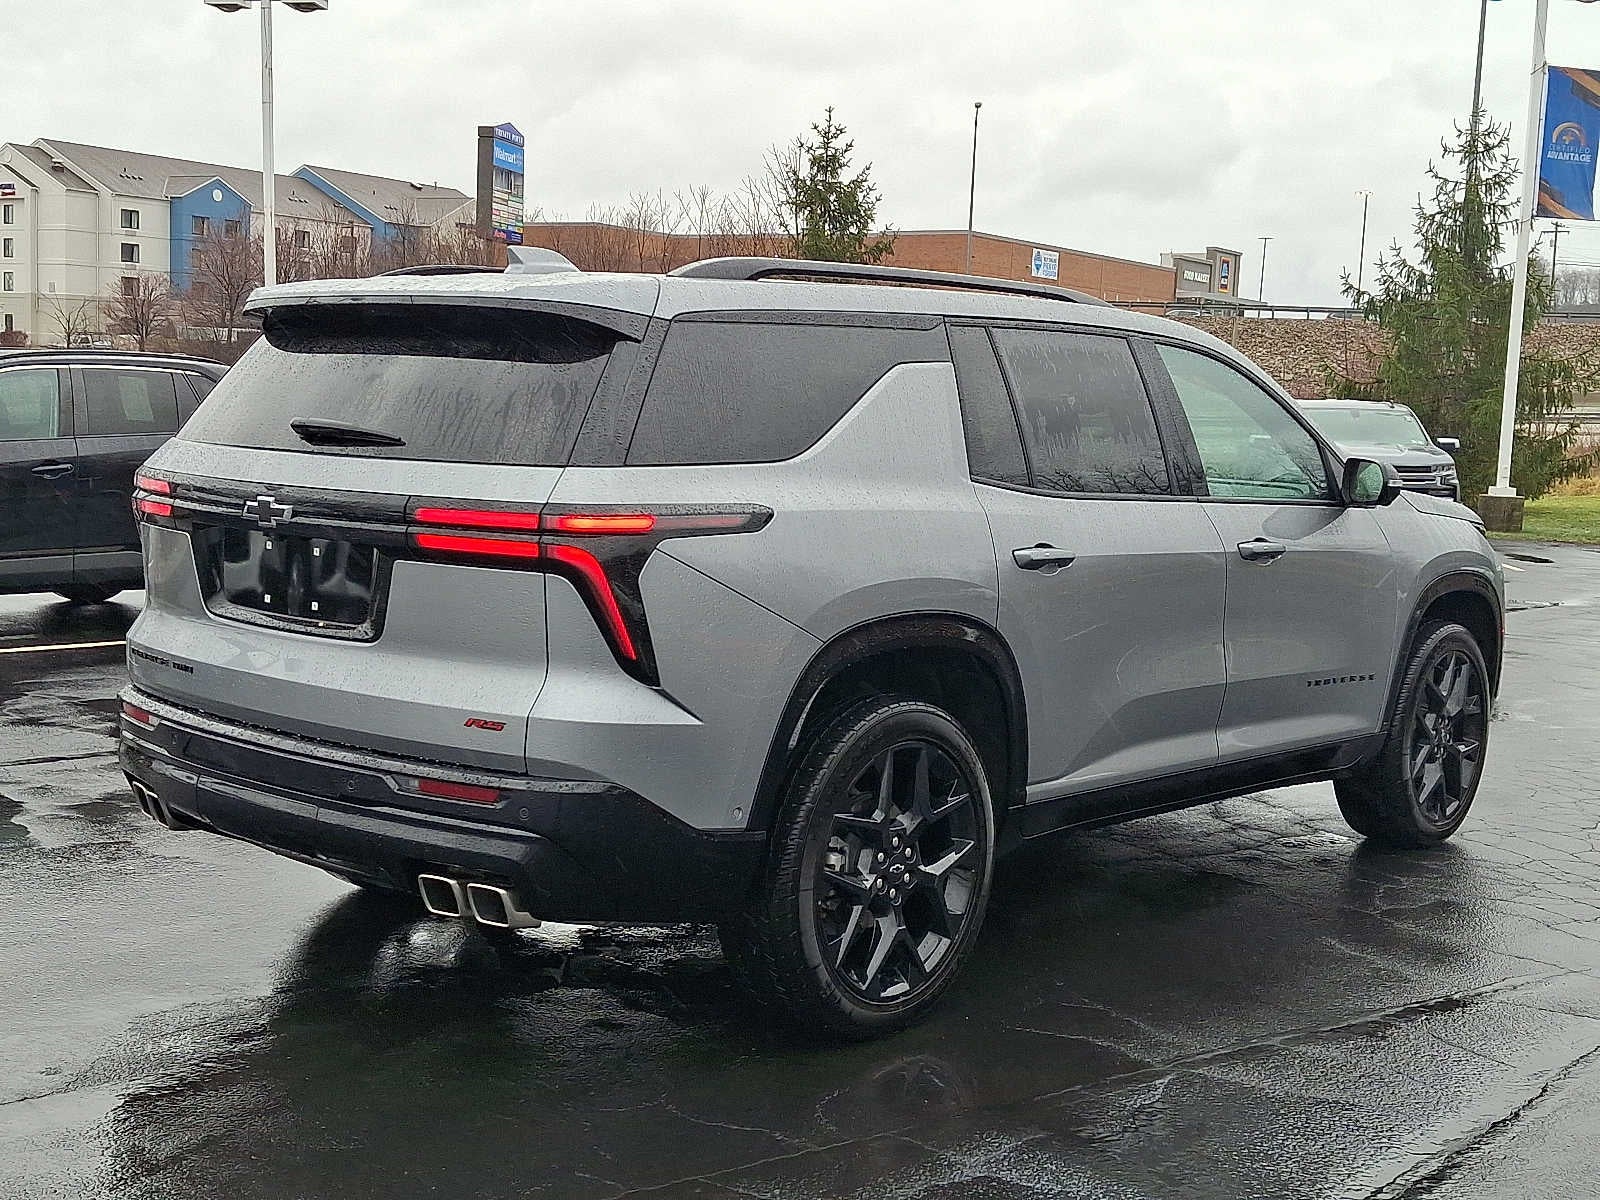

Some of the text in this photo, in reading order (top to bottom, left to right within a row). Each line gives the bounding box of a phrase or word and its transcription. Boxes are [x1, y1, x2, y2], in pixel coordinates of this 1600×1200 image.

[495, 146, 516, 164] Walmart
[1547, 150, 1593, 163] ADVANTAGE
[464, 717, 507, 731] RS
